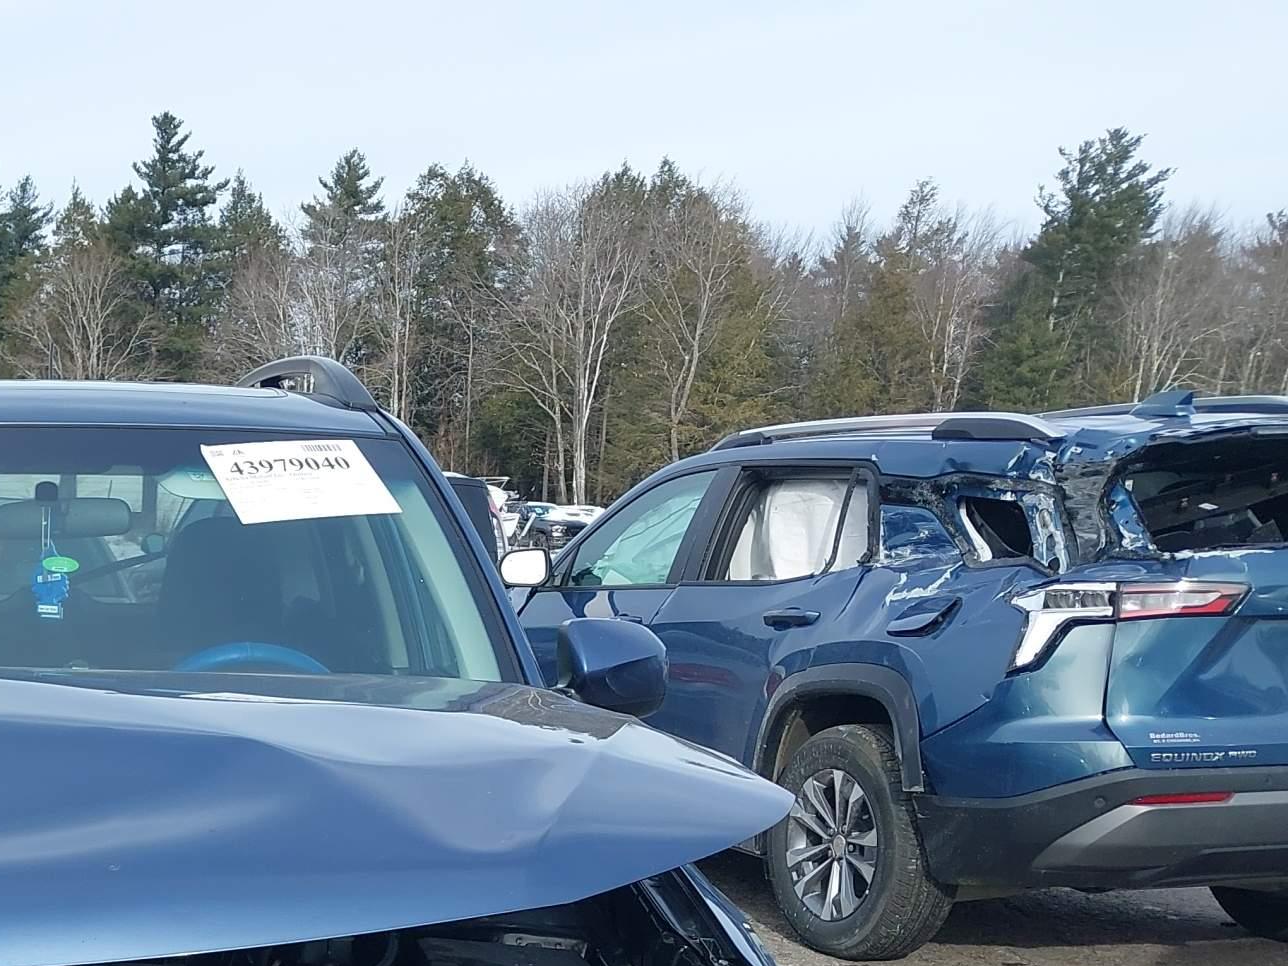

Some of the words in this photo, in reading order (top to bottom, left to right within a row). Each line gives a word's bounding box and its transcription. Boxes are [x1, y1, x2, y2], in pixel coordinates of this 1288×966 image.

[230, 456, 350, 475] 43979040
[1150, 752, 1225, 762] EQUINOX
[1228, 750, 1257, 758] AWD
